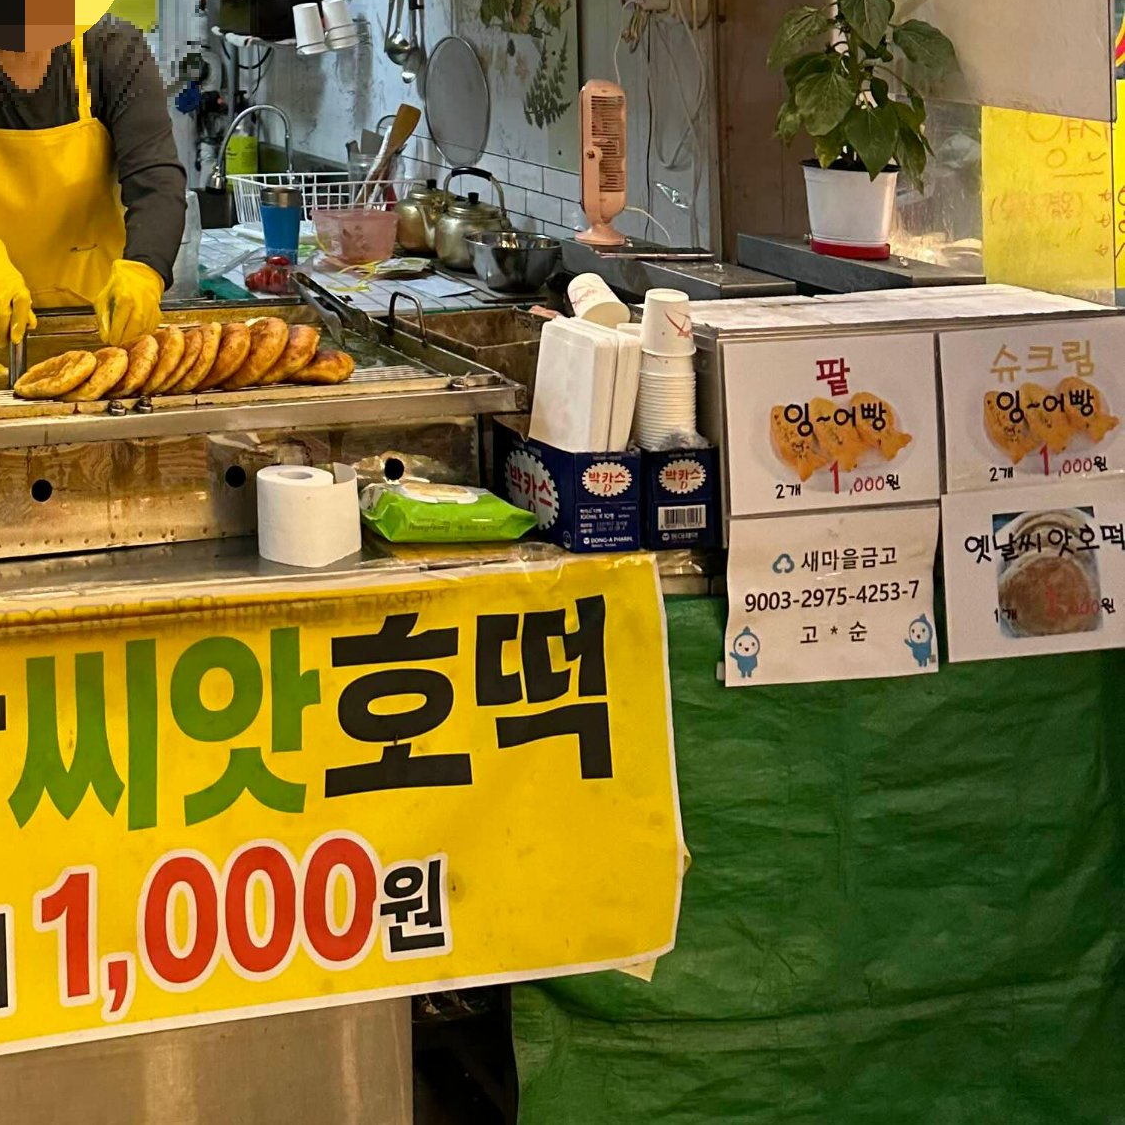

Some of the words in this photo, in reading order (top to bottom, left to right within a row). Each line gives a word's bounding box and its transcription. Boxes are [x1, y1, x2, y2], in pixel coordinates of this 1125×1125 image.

[990, 340, 1095, 383] 슈크림
[816, 357, 851, 397] 팥
[509, 463, 553, 507] 박카스
[588, 471, 626, 484] 박카스
[665, 468, 701, 482] 박카스
[679, 481, 689, 490] D
[989, 466, 1014, 482] 2개
[603, 483, 612, 493] D
[775, 483, 802, 499] 2개
[801, 547, 897, 572] 새마을금고
[745, 580, 920, 613] 9003-2975-4253-7
[800, 626, 819, 644] 고
[848, 621, 868, 642] 순
[39, 836, 448, 1016] 1,000원
